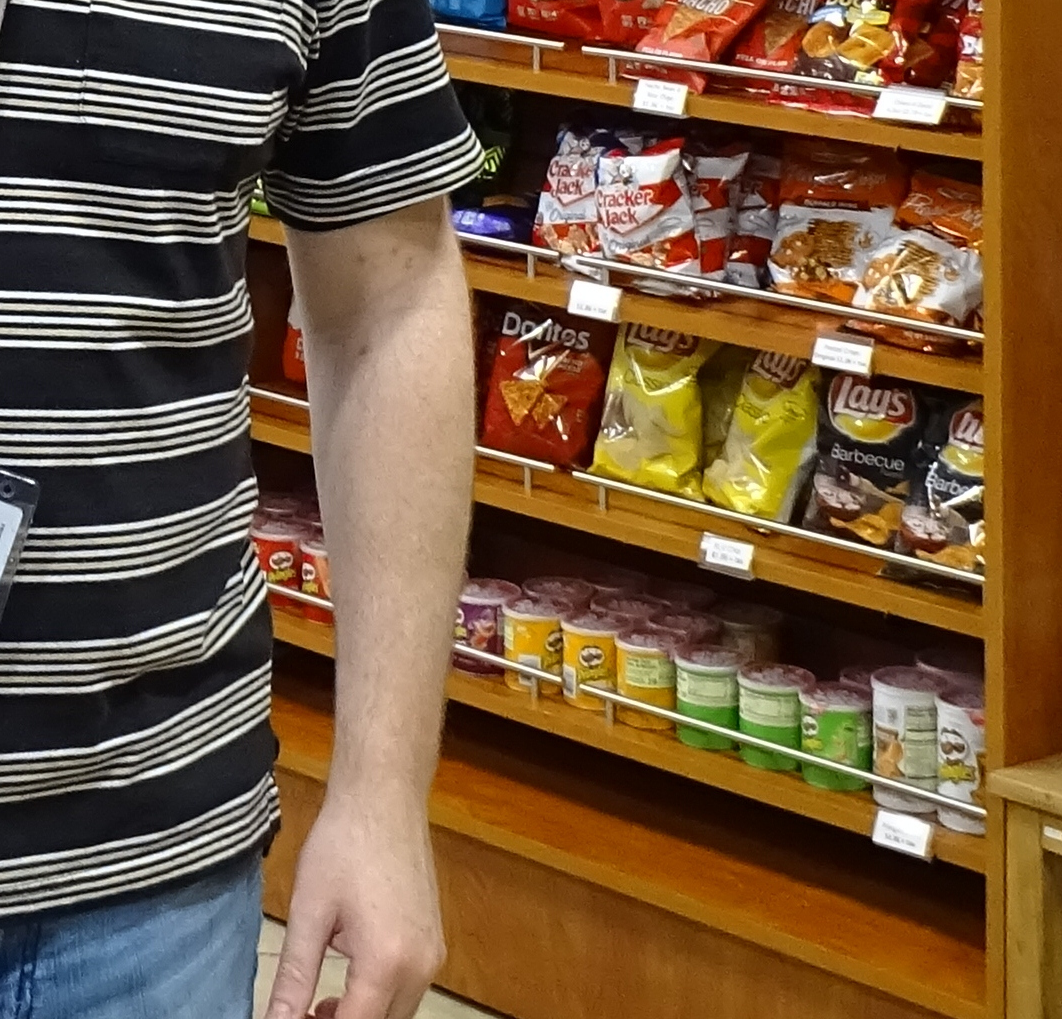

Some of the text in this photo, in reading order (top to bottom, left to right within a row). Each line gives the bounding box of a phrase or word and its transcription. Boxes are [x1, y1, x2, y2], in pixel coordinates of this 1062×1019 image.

[549, 160, 593, 178] Crake
[551, 177, 584, 198] Jack
[595, 189, 654, 208] Cracker
[605, 206, 639, 229] Jack
[627, 323, 694, 353] Lays
[833, 375, 909, 421] Lay's
[831, 442, 906, 472] Barbecue
